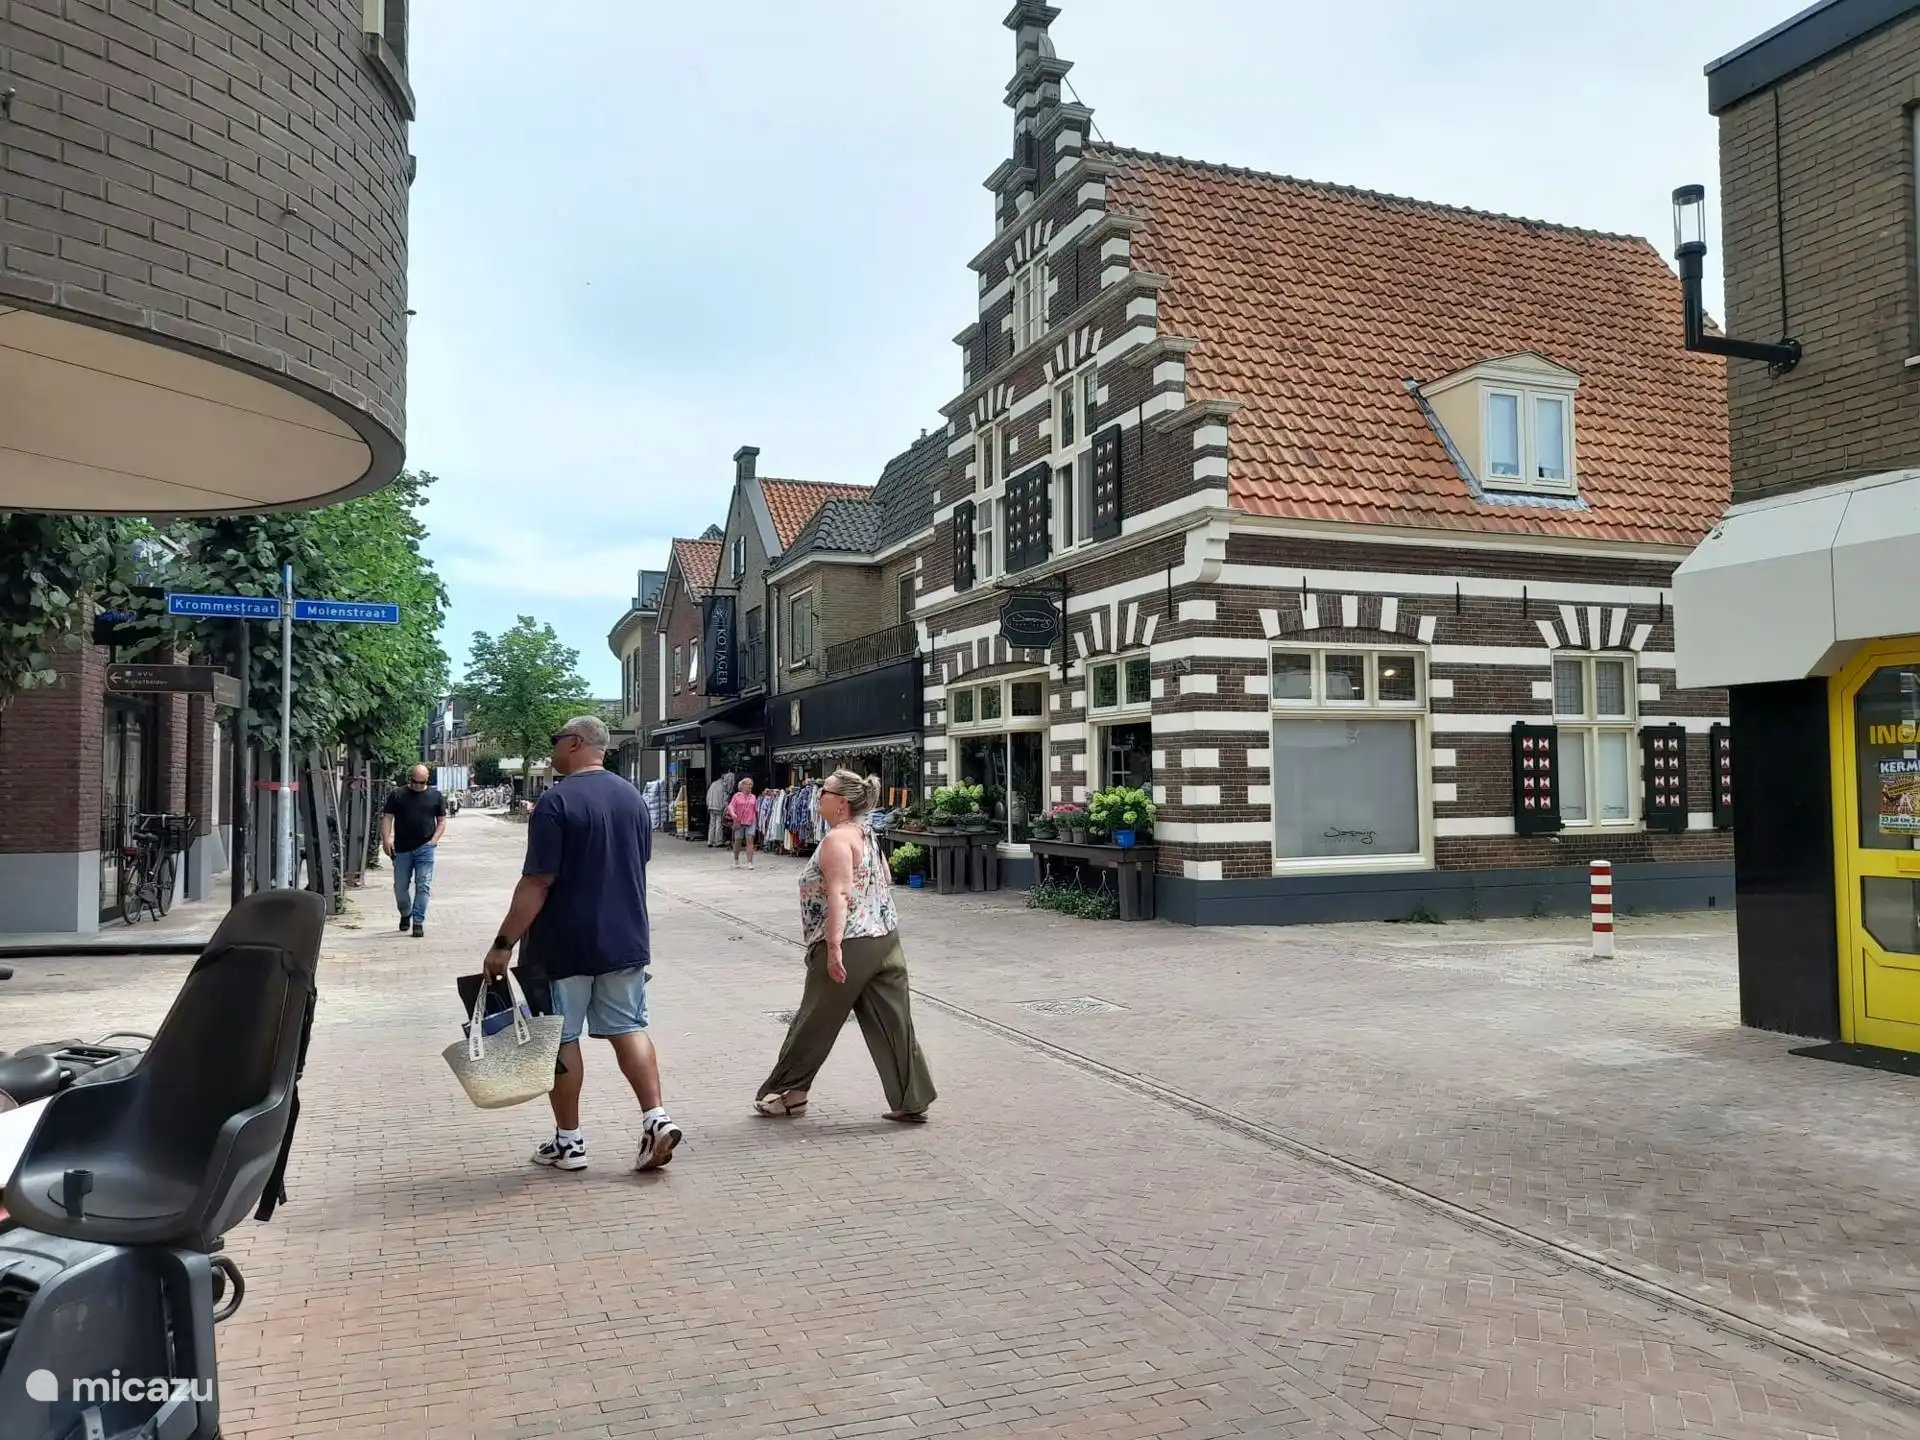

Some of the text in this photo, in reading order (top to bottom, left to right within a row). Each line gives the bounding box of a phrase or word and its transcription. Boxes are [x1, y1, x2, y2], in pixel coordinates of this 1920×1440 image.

[175, 599, 275, 614] Krommestraat
[307, 605, 387, 619] Molenstraat
[1869, 724, 1920, 744] ING
